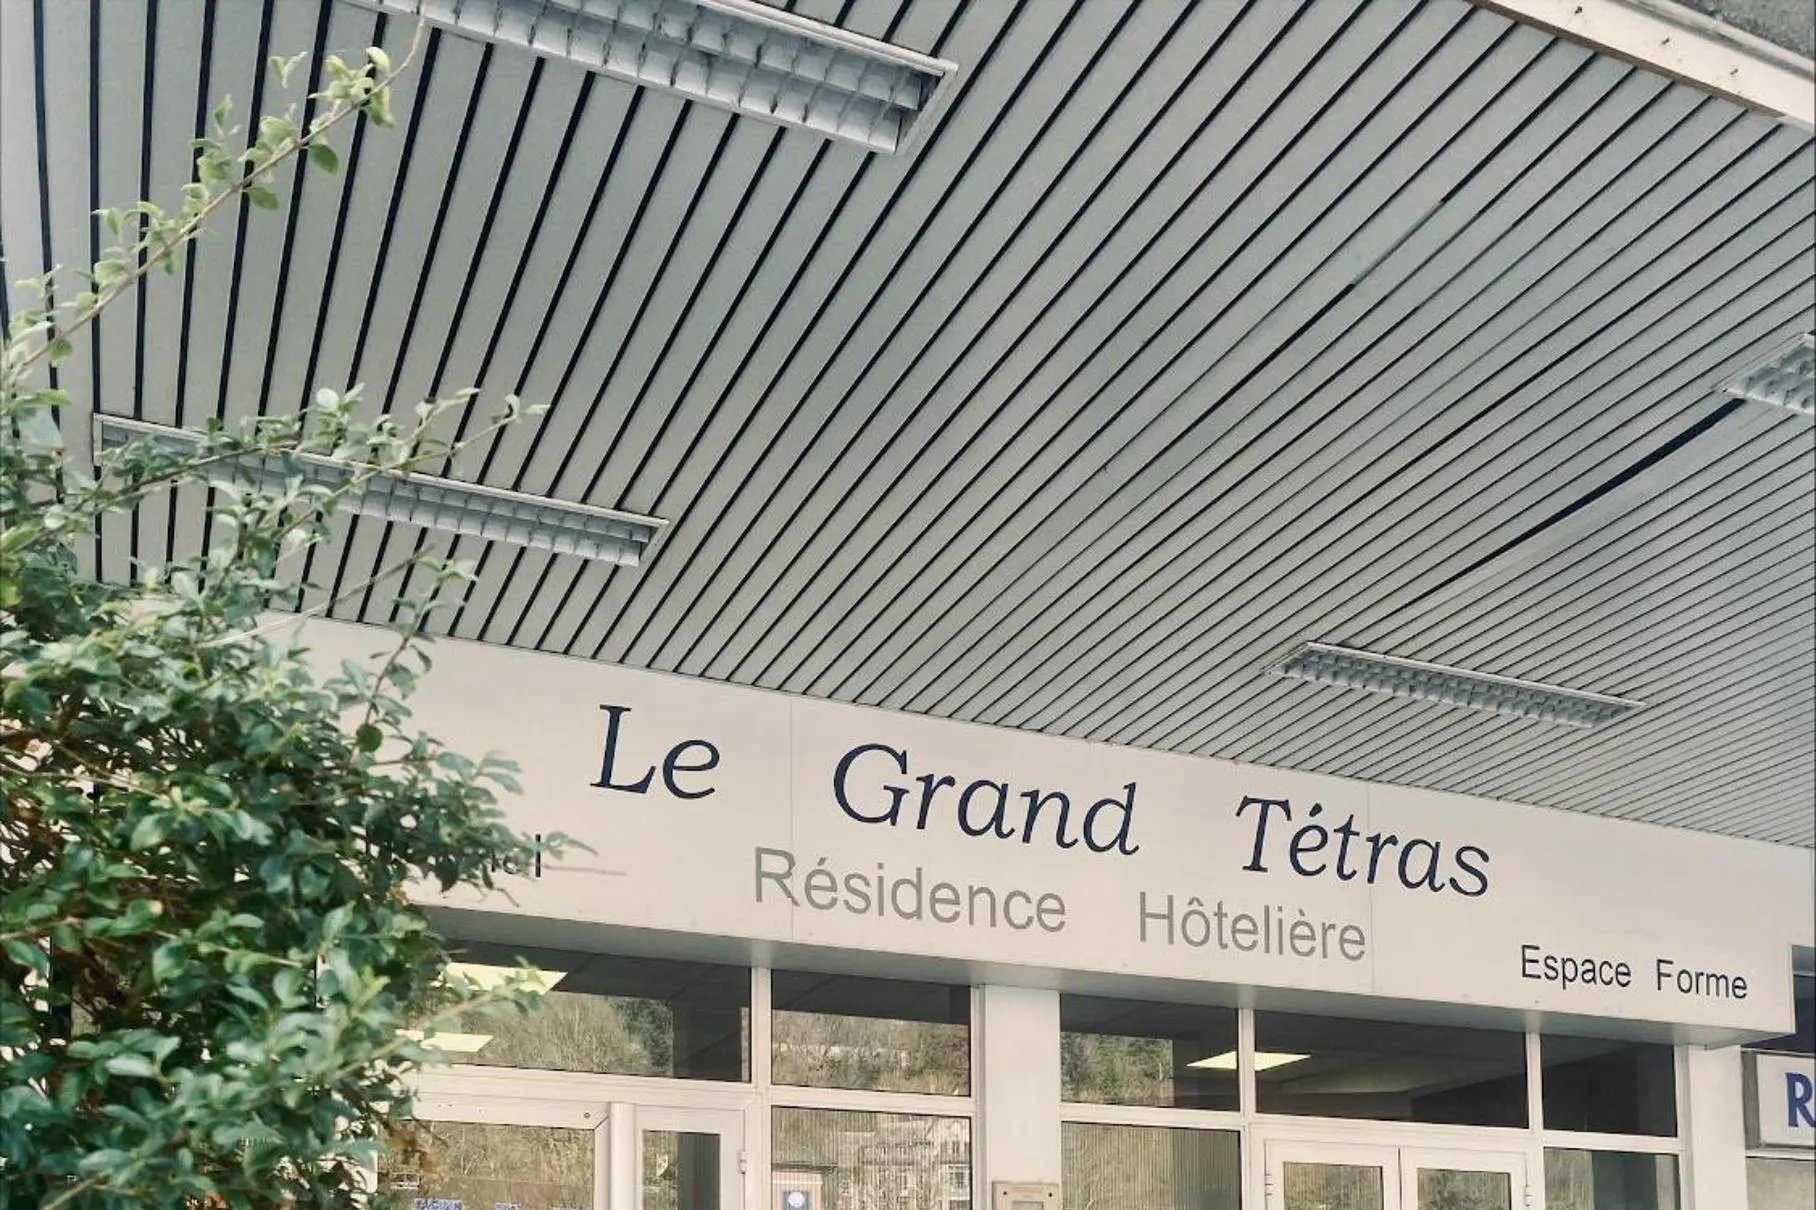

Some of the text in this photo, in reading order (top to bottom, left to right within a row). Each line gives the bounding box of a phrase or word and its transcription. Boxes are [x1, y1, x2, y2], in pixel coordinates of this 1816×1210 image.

[589, 704, 1490, 897] Le Grand Tétras
[754, 846, 1367, 962] Résidence Hôtelière
[1521, 944, 1748, 999] Espace Forme
